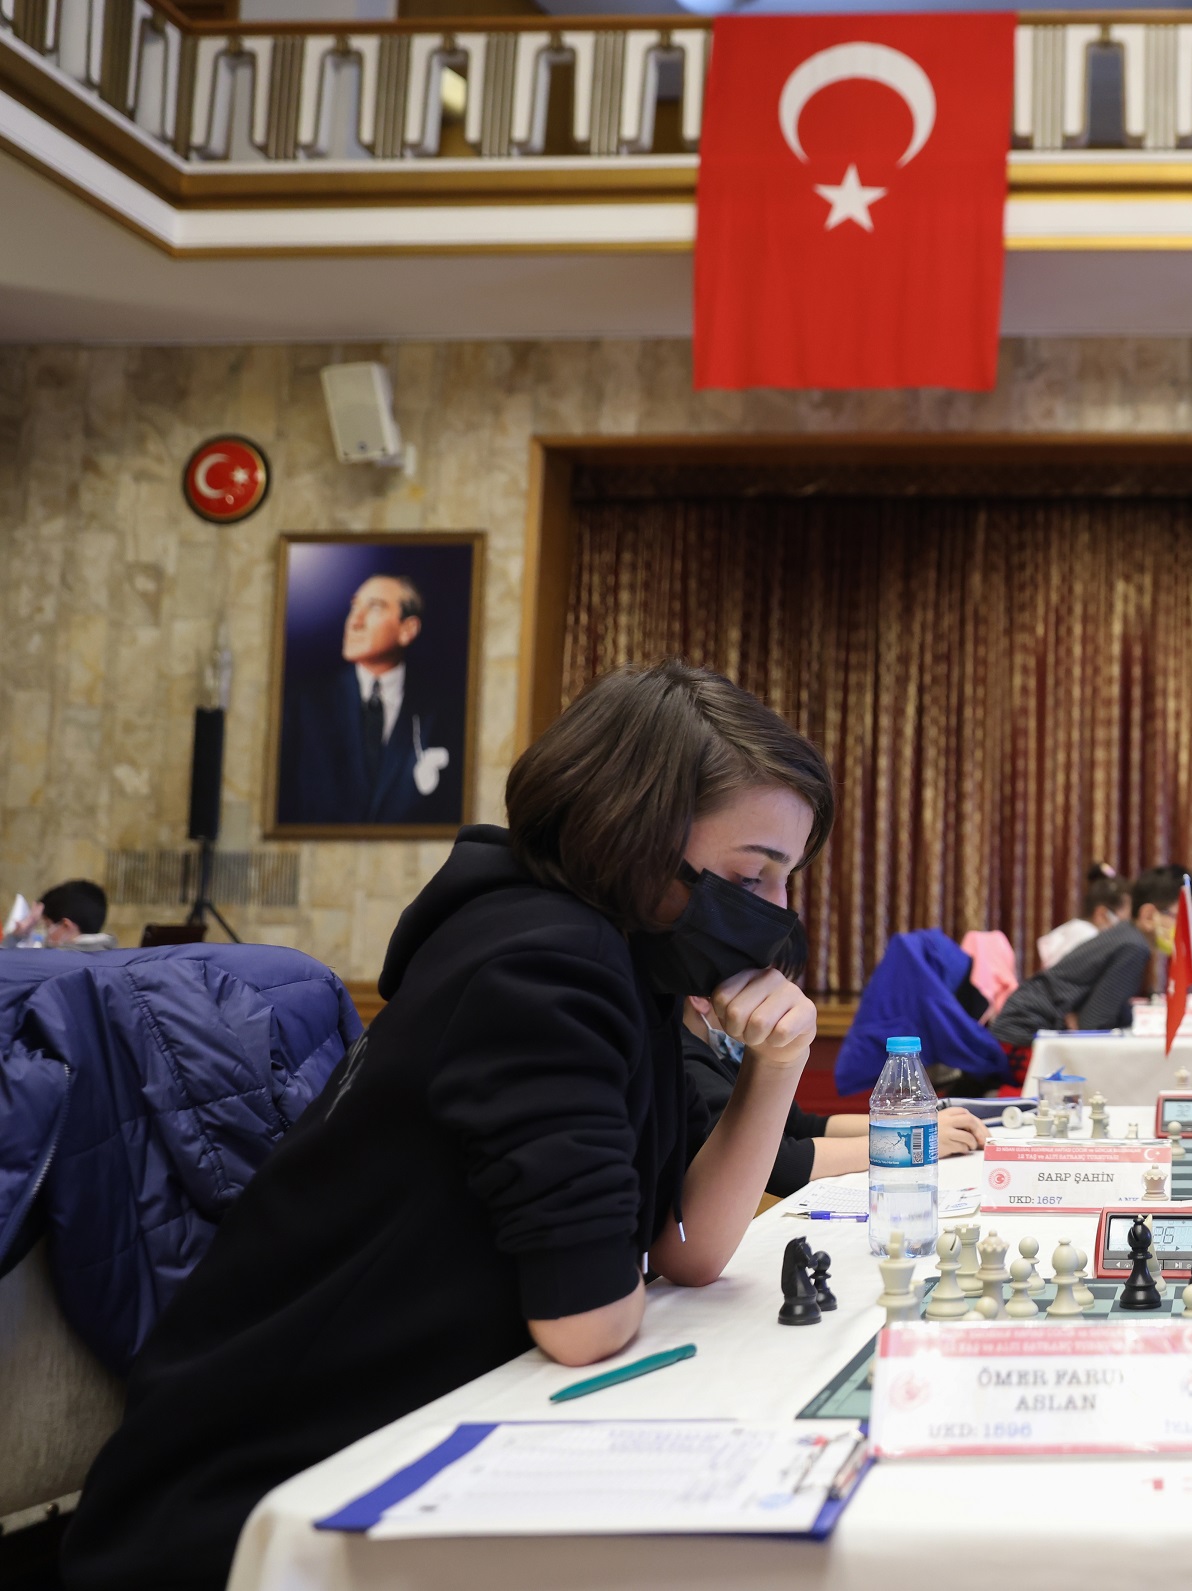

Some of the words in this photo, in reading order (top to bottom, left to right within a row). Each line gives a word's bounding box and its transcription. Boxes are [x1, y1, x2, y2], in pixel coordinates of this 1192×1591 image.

[1037, 1173, 1071, 1182] SARP
[1074, 1171, 1115, 1184] ŞAHİN
[1009, 1195, 1035, 1204] UKD:
[1036, 1196, 1063, 1205] 1657
[976, 1366, 1048, 1388] ÖMER
[1054, 1368, 1125, 1386] FARU
[1014, 1393, 1098, 1412] ASLAN
[929, 1422, 979, 1439] UKD:
